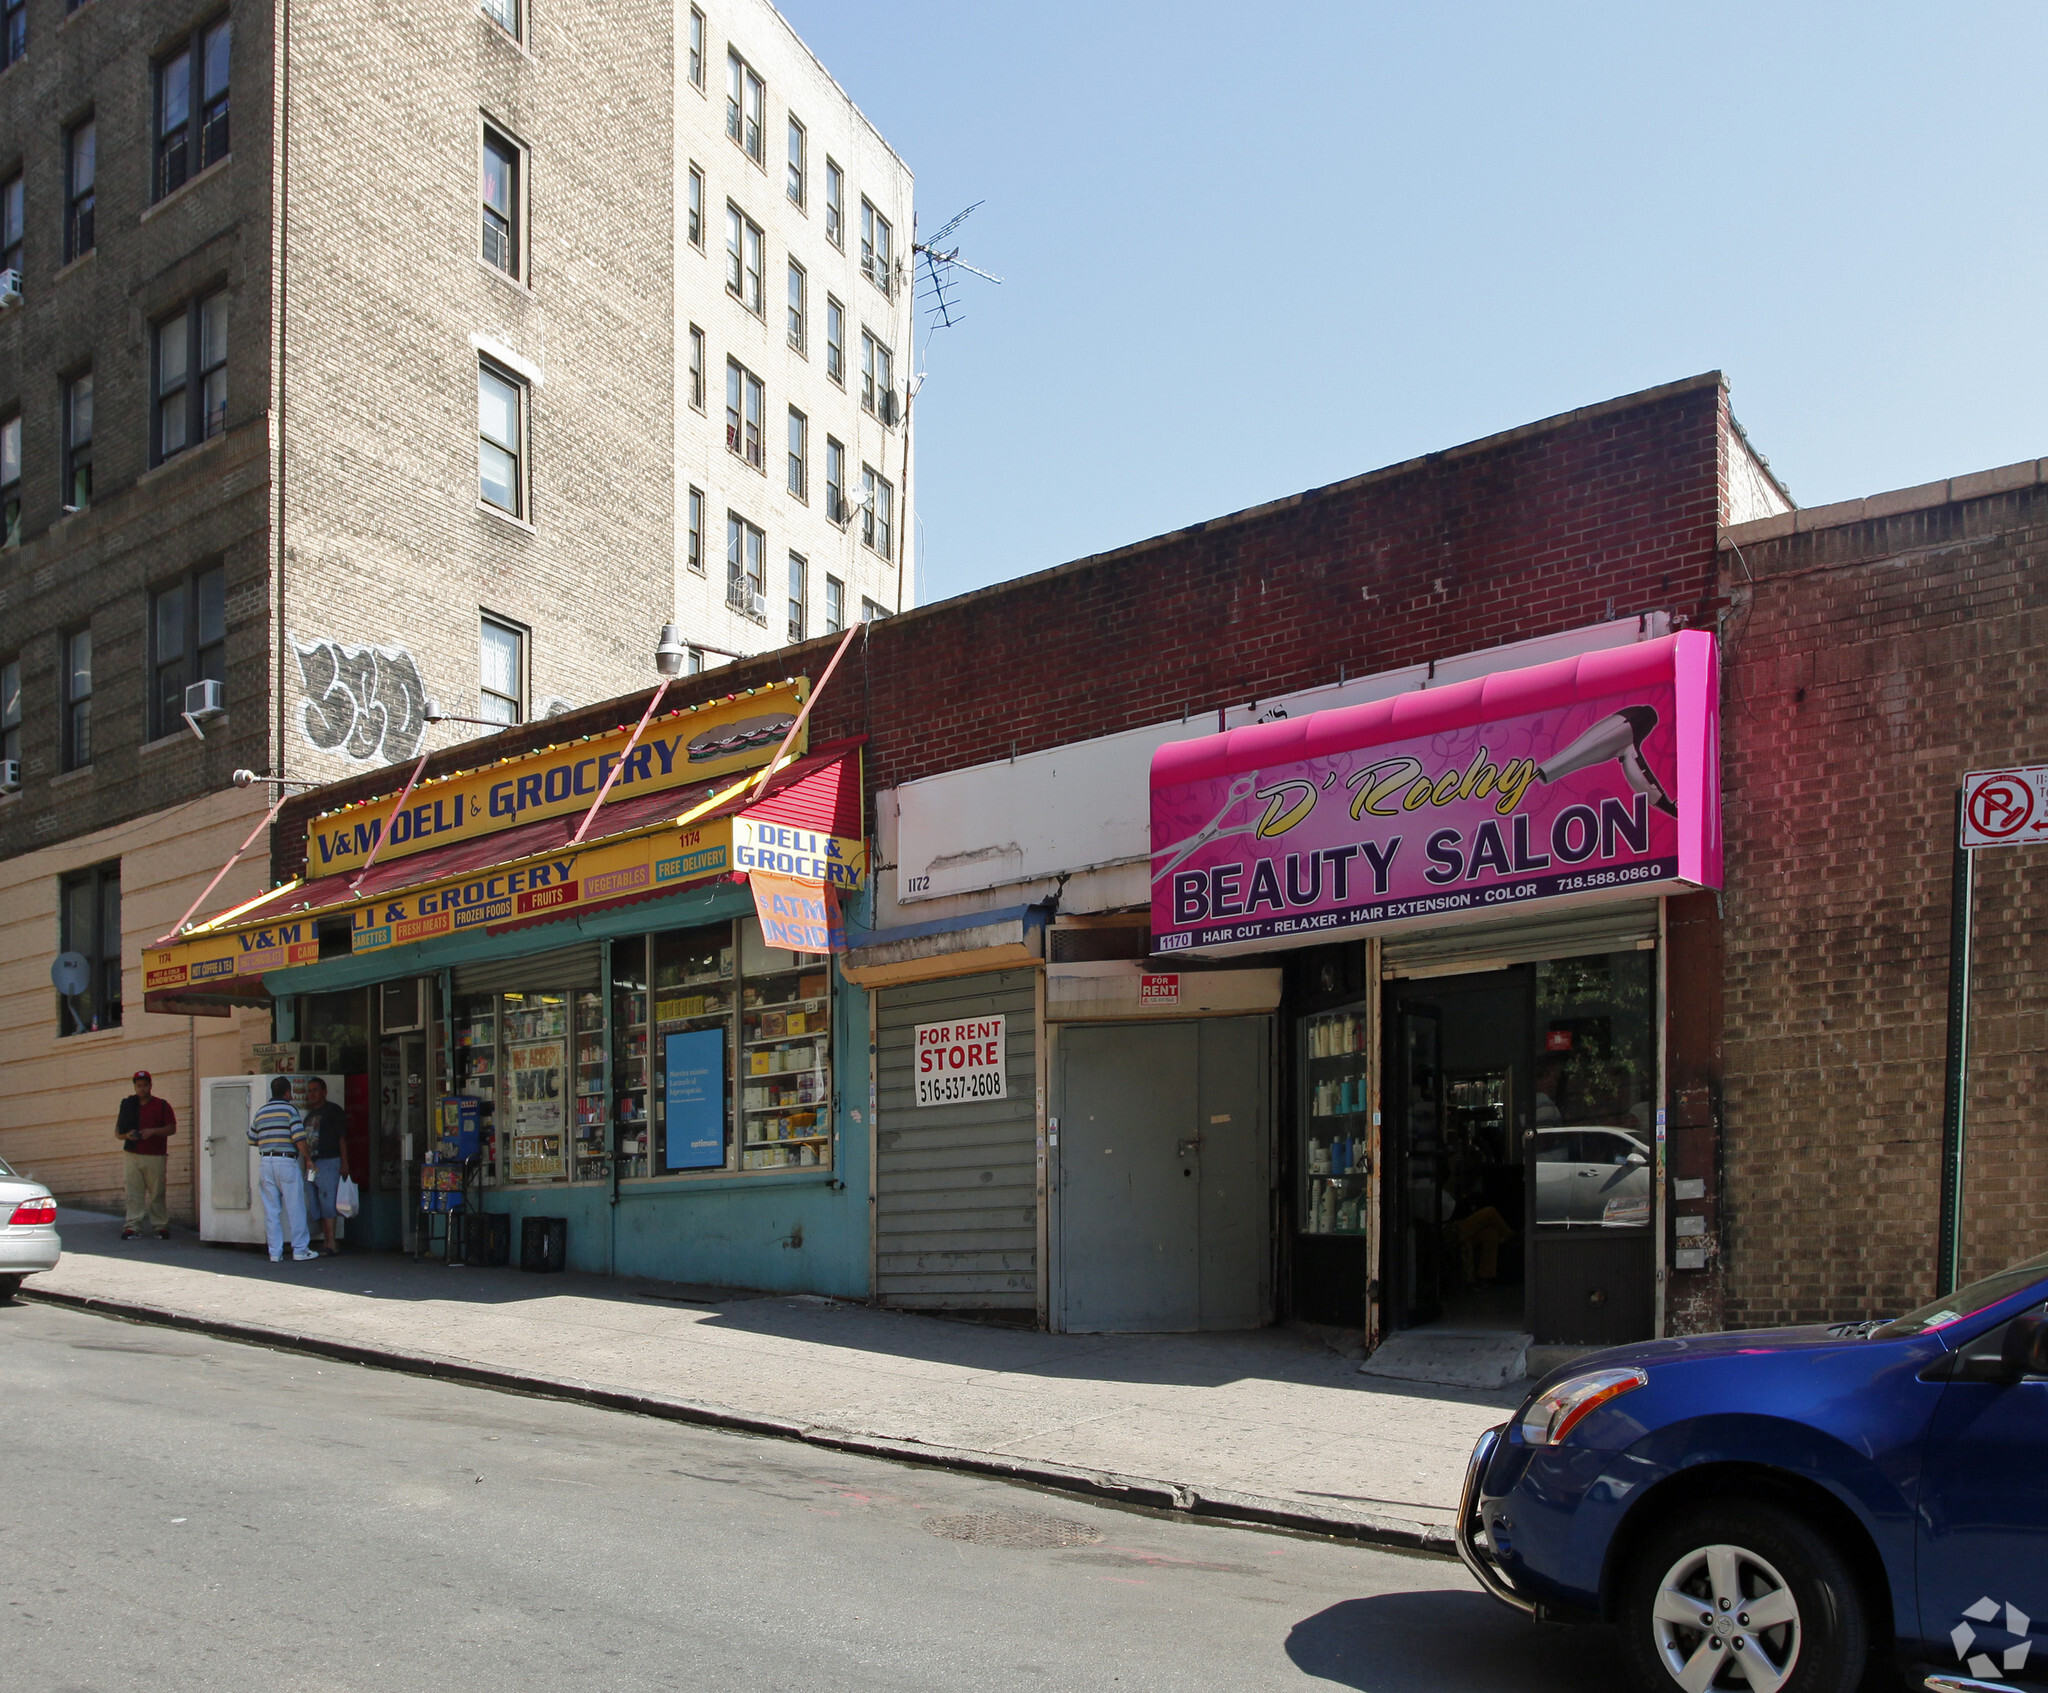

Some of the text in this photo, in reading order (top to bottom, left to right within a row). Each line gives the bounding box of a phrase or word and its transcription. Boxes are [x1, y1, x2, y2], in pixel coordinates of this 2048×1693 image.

[1346, 745, 1543, 822] Rochy
[317, 734, 683, 864] V&M DELI & GROCERY
[679, 830, 701, 848] 1174
[758, 823, 844, 860] DELI &
[658, 849, 725, 878] FREE DELIVERY
[737, 845, 862, 885] GROCERY
[1173, 792, 1650, 925] BEAUTY SALON
[588, 869, 646, 895] VEGETABLES
[908, 876, 930, 893] 1172
[1556, 864, 1661, 892] 718.588.0860
[239, 924, 301, 952] V&M
[385, 901, 408, 924] &
[418, 857, 577, 916] GROCERY
[532, 888, 563, 908] FRUITS
[772, 894, 827, 921] ATM
[398, 914, 447, 938] FRESH MEATS
[456, 901, 511, 925] FROZEN FOODS
[1162, 883, 1537, 949] 1170 HAIR CUT RELAXER HAIR EXTENSION COLOR
[353, 929, 388, 948] GARETTES
[763, 918, 848, 949] INSIDE
[158, 952, 171, 964] 1174
[192, 965, 202, 977] HOT
[202, 962, 218, 975] COFFEE
[223, 960, 232, 971] TEA
[252, 951, 282, 966] CHOCOLATE
[148, 973, 186, 986] SANDWICHES
[1143, 985, 1177, 996] RENT
[1151, 977, 1169, 985] FOR
[919, 1020, 1001, 1046] FOR RENT
[275, 1056, 295, 1072] ICE
[919, 1041, 999, 1073] STORE
[516, 1069, 559, 1101] WIC
[919, 1071, 1001, 1104] 516-537-2608
[515, 1139, 540, 1158] EBT
